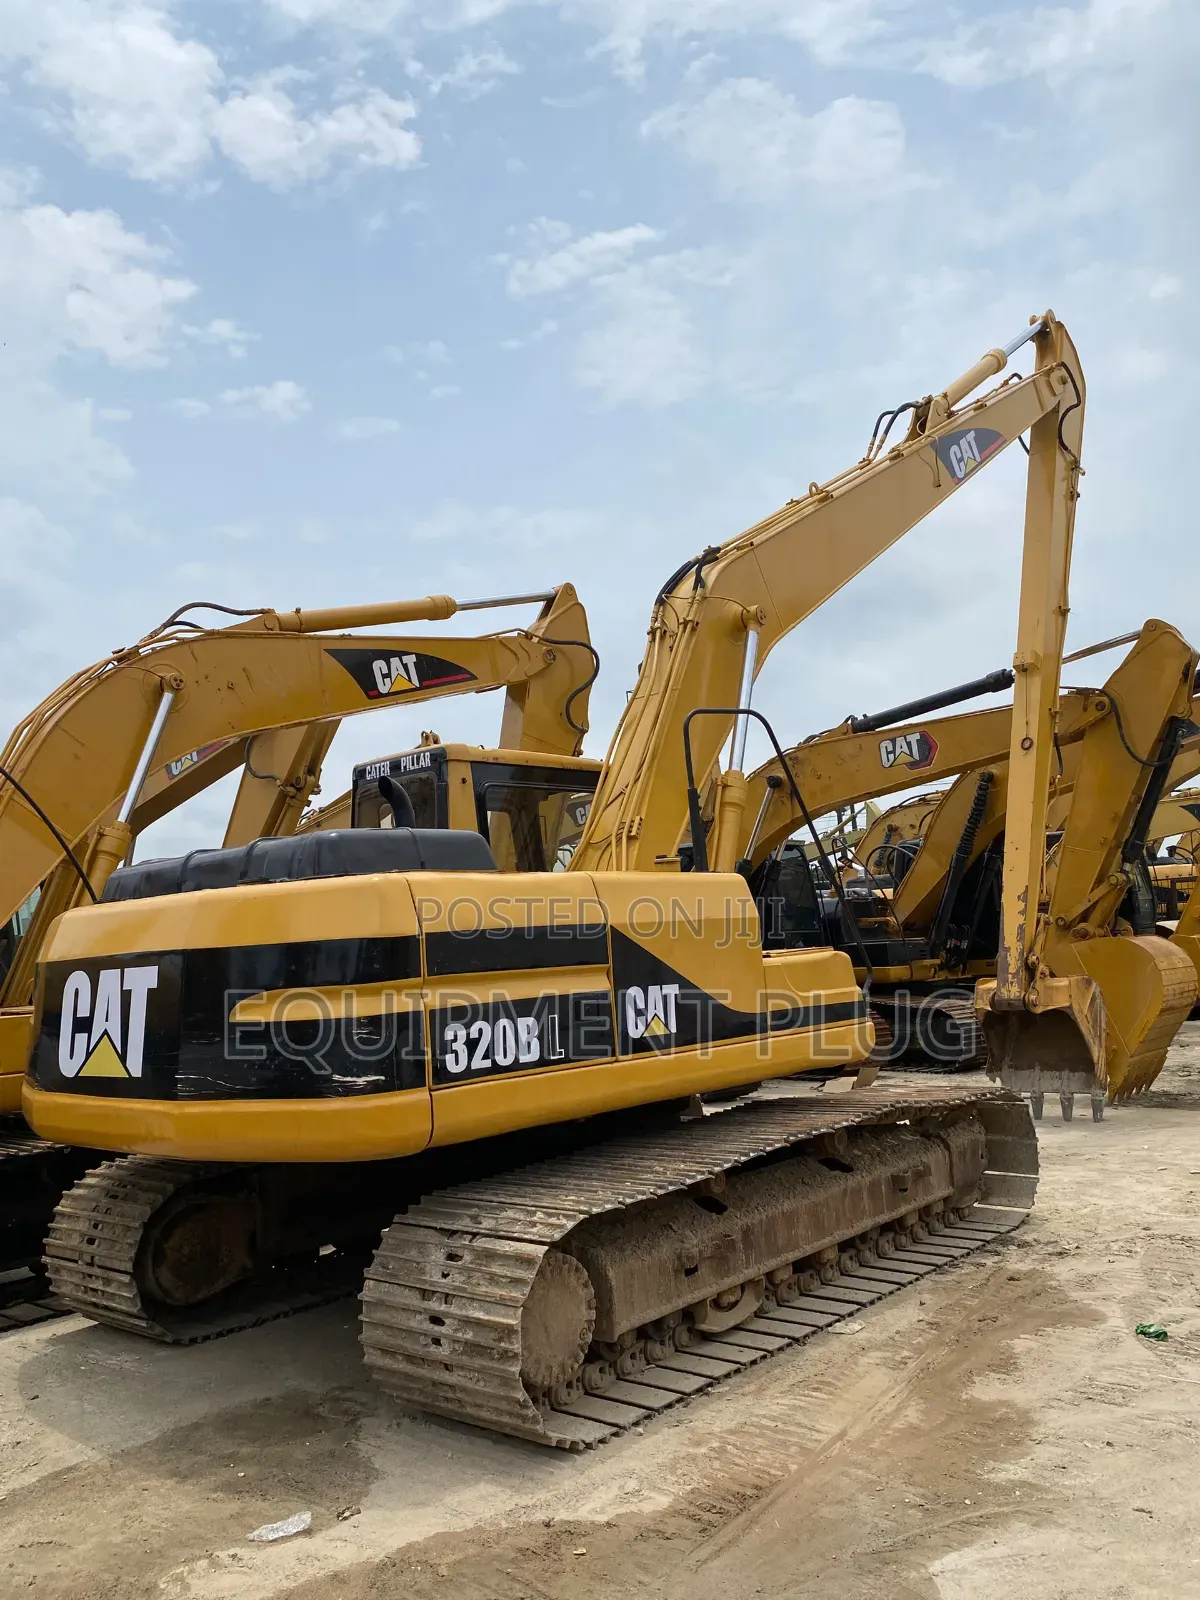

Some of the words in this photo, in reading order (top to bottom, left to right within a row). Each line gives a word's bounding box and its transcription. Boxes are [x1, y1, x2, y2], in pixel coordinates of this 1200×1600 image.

[949, 430, 981, 478] CAT
[372, 654, 420, 694] CAT
[365, 760, 391, 780] CATER
[400, 751, 431, 773] PILLAR
[880, 732, 920, 768] CAT
[58, 965, 159, 1078] CAT
[625, 983, 680, 1039] CAT
[444, 1016, 540, 1074] 320B
